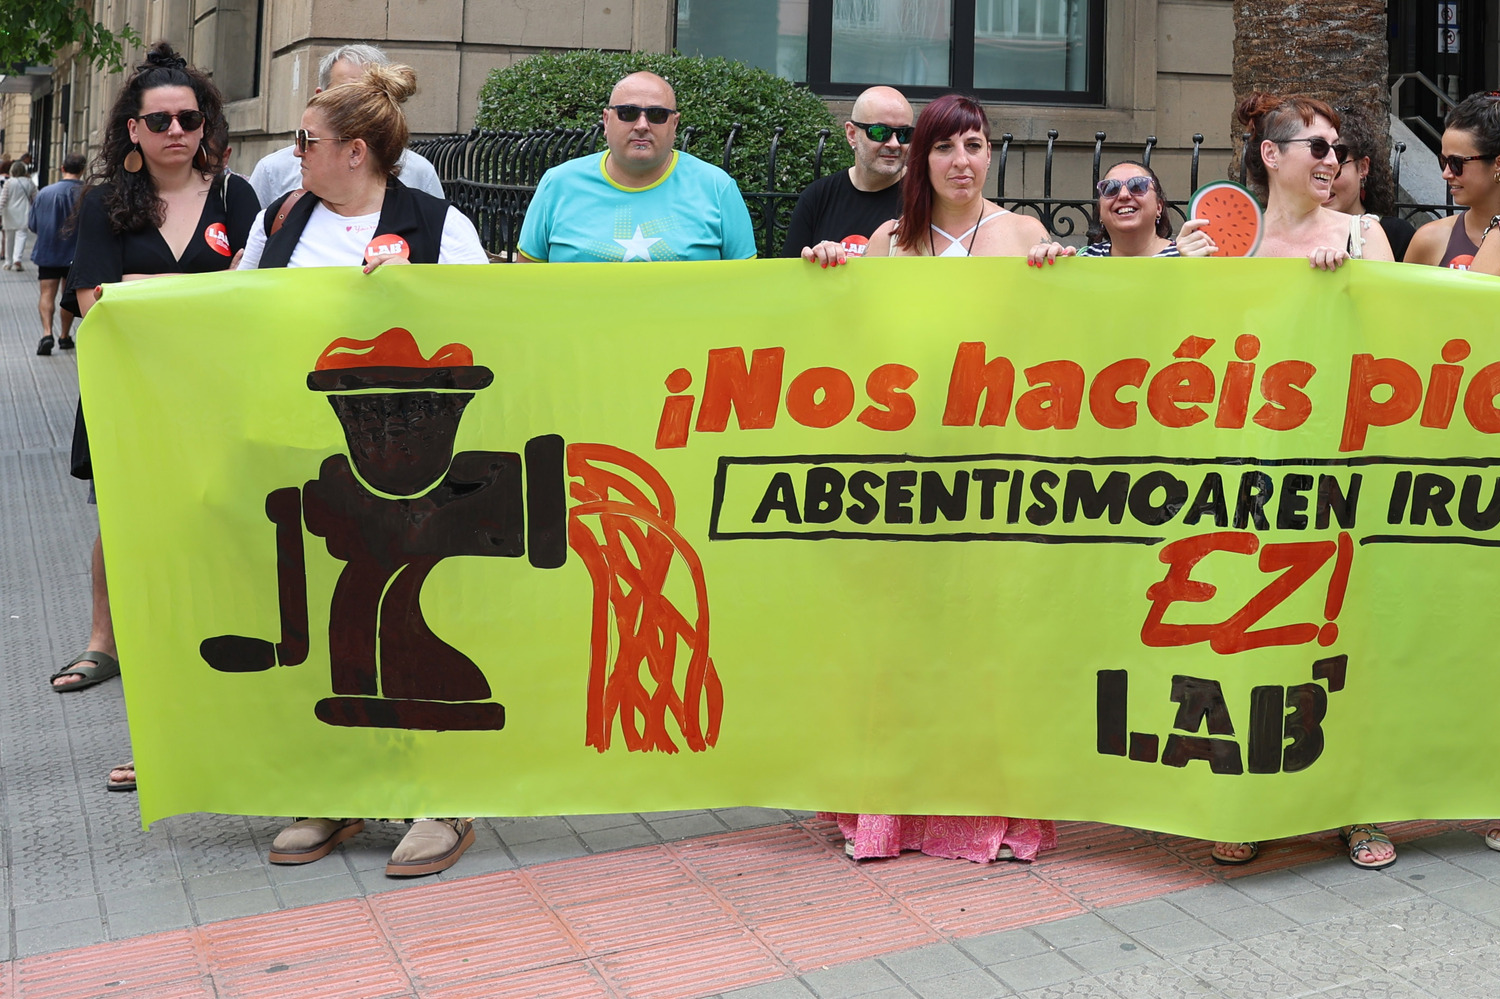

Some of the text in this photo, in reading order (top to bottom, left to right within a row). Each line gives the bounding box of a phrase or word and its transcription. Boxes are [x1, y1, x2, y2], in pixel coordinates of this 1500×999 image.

[941, 334, 1318, 431] hacéis
[751, 466, 1363, 531] ABSENTISMOAREN
[1140, 530, 1354, 655] EZ!
